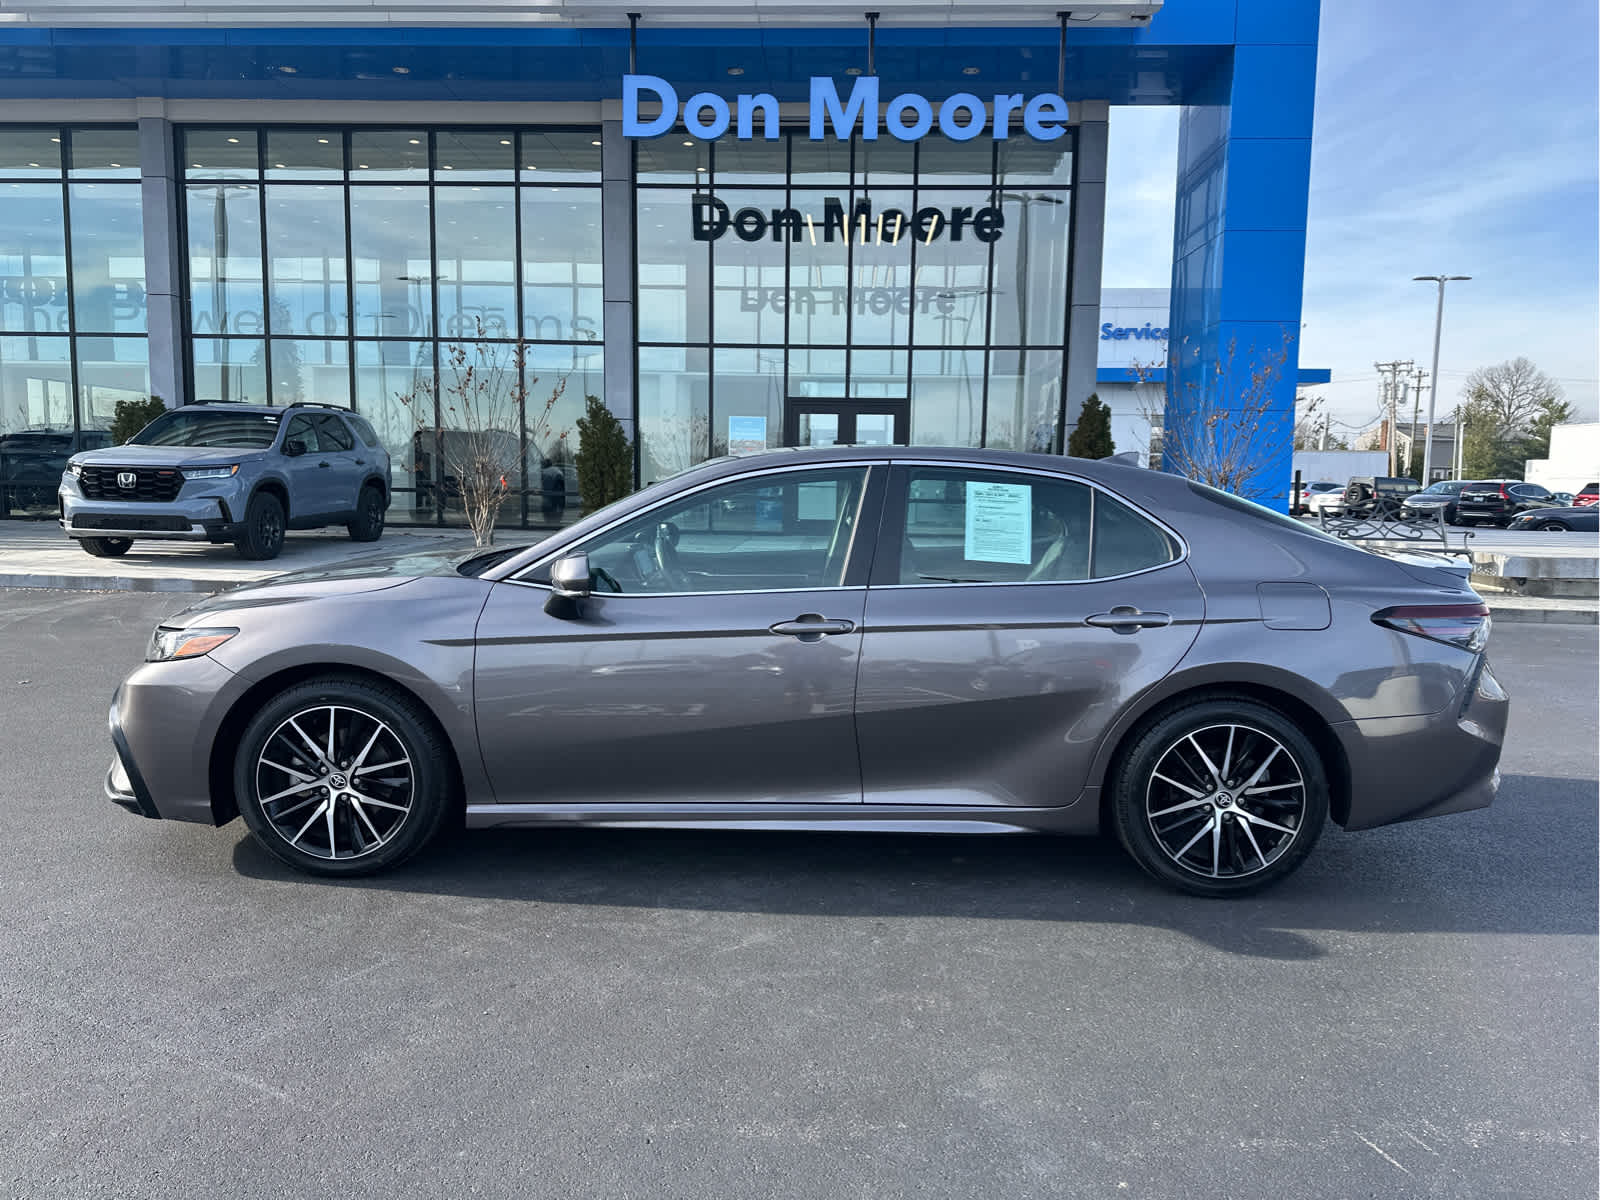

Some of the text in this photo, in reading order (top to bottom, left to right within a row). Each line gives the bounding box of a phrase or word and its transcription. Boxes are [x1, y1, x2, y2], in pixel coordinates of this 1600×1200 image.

[622, 74, 1069, 142] Don Moore
[691, 193, 1004, 243] Don Moore
[1101, 322, 1169, 340] Service
